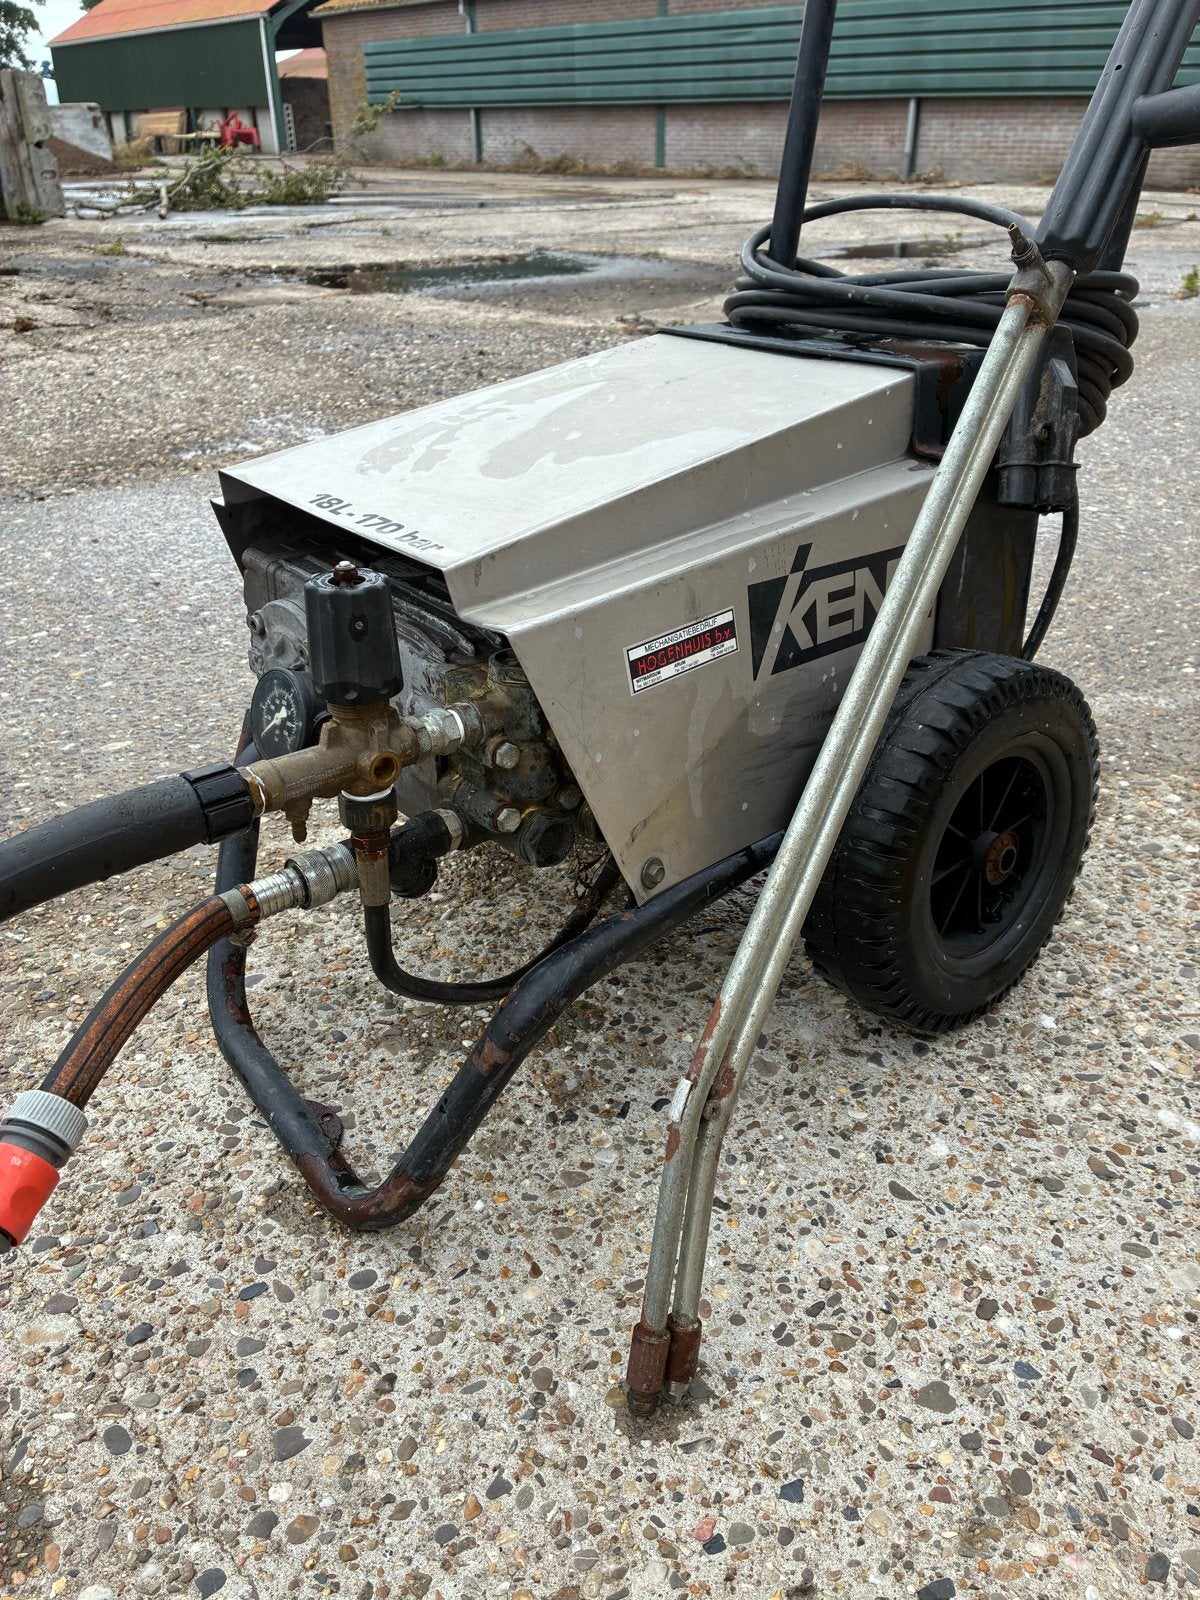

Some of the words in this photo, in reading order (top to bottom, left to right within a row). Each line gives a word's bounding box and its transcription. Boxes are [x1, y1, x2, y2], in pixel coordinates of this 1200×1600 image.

[394, 530, 445, 551] bar
[644, 618, 718, 653] MECHANISATIEBEDRIJF
[636, 632, 712, 676] HOGENHUIS
